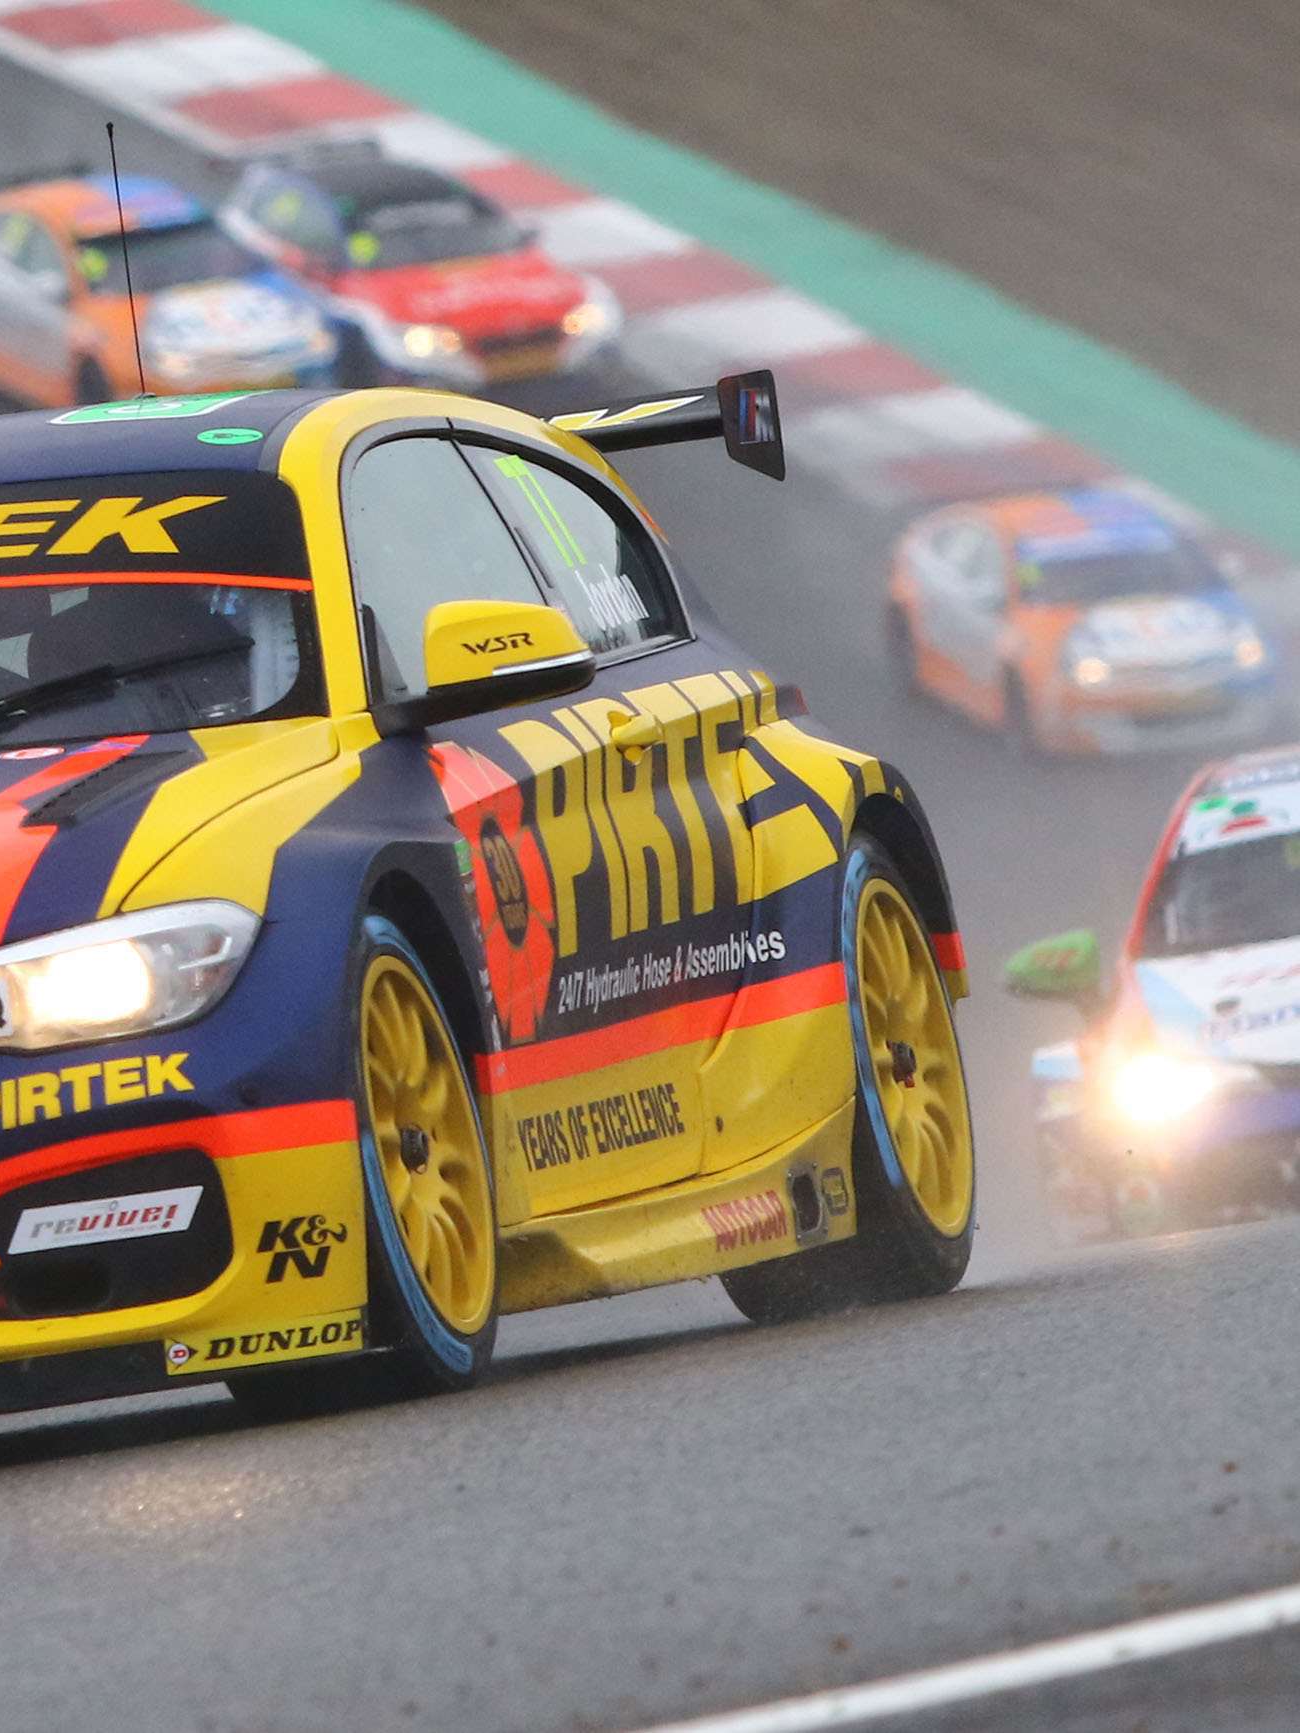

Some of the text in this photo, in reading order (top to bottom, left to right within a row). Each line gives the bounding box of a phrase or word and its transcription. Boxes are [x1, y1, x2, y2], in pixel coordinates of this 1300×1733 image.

[461, 632, 534, 655] WSR
[558, 971, 584, 1014] 24/7
[585, 956, 641, 1014] Hydraulic
[642, 952, 672, 991] Hose
[516, 1083, 686, 1172] YEARS OF EXCELLENCE
[203, 1319, 362, 1362] DUNLOP
